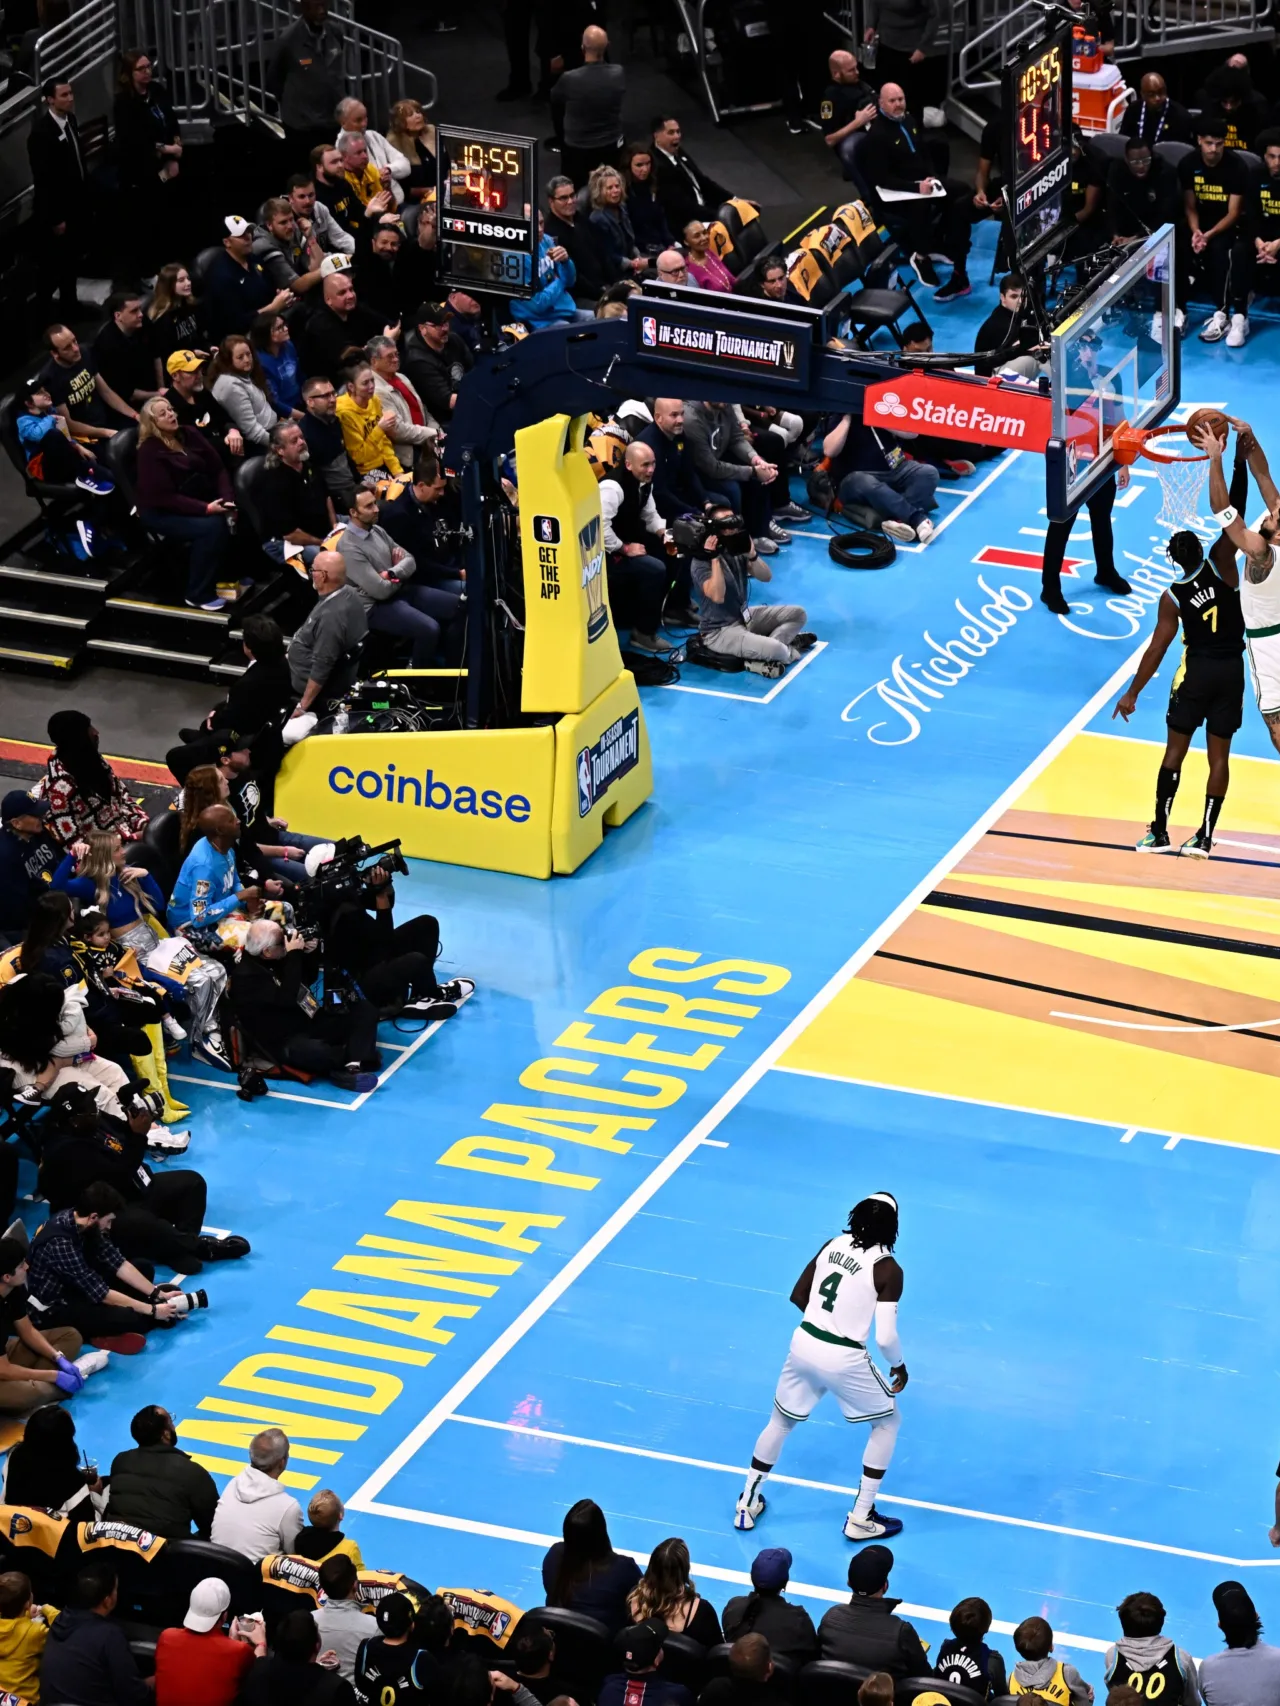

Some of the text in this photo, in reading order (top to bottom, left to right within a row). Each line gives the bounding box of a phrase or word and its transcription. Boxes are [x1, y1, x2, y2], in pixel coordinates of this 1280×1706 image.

[1021, 46, 1061, 103] 10:55
[464, 144, 519, 176] 10:55
[1031, 157, 1070, 201] TISSOT
[466, 221, 528, 242] TISSOT
[659, 324, 784, 367] IN-SEASON TOURNAMENT
[538, 546, 558, 565] GET
[581, 551, 606, 590] INDY
[539, 564, 560, 583] THE
[540, 582, 561, 601] APP
[1189, 586, 1216, 609] HIELD
[1202, 605, 1218, 633] 7
[840, 574, 1034, 746] Michelob
[591, 716, 638, 797] TOURNAMENT
[328, 763, 531, 823] coinbase
[435, 946, 792, 1191] PACERS
[828, 1251, 863, 1276] HOLIDAY
[819, 1271, 844, 1314] 4
[938, 1653, 981, 1679] HALIBURTON
